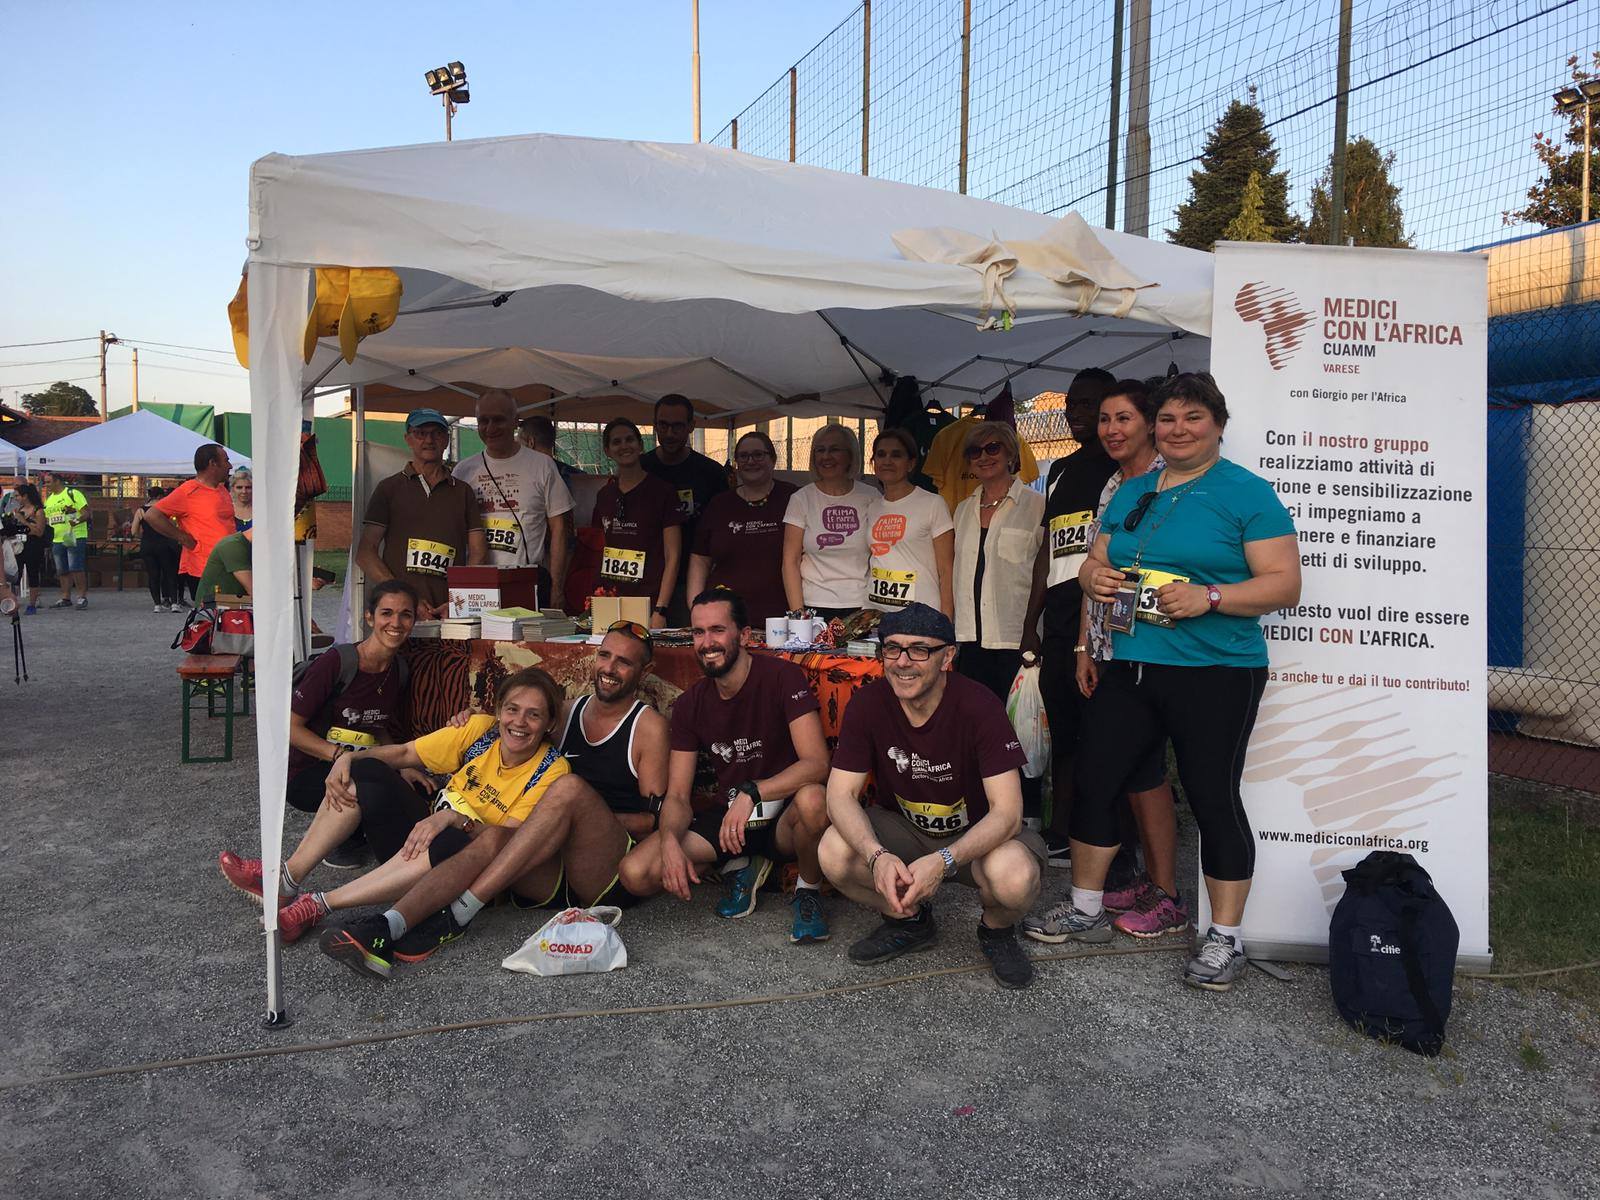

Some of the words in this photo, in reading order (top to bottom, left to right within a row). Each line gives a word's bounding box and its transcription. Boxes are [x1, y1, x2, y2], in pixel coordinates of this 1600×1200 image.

[1324, 298, 1397, 320] MEDICI
[1323, 320, 1367, 341] CON
[1375, 323, 1463, 345] L’AFRICA
[1323, 343, 1376, 357] CUAMM
[1323, 363, 1361, 374] VARESE
[1290, 389, 1309, 399] con
[1312, 389, 1348, 402] Giorgio
[1351, 392, 1368, 403] per
[1371, 392, 1407, 403] l'Africa
[1266, 430, 1296, 446] Con
[1303, 432, 1312, 447] il
[1319, 433, 1368, 449] nostro
[1374, 438, 1429, 455] gruppo
[1259, 455, 1353, 473] realizziamo
[1359, 459, 1413, 476] attività
[1420, 461, 1435, 477] di
[1317, 483, 1327, 495] e
[1332, 482, 1472, 502] sensibilizzazione
[1308, 504, 1406, 524] impegniamo
[1412, 512, 1421, 524] a
[1053, 525, 1086, 548] 1824
[1341, 533, 1350, 545] e
[1356, 530, 1436, 549] finanziare
[412, 551, 450, 571] 1844
[604, 559, 639, 576] 1843
[1333, 553, 1348, 569] di
[1354, 556, 1427, 576] sviluppo.
[873, 580, 910, 598] 1847
[1278, 604, 1331, 620] questo
[1338, 605, 1371, 621] vuol
[1377, 607, 1409, 623] dire
[1415, 612, 1469, 626] essere
[1262, 624, 1313, 642] MEDICI
[1319, 627, 1353, 644] CON
[1282, 671, 1318, 684] anche
[1322, 672, 1333, 684] tu
[1338, 675, 1345, 685] e
[1349, 674, 1367, 686] dai
[1372, 674, 1379, 687] il
[1383, 676, 1401, 688] tuo
[1406, 677, 1470, 692] contributo!
[903, 807, 961, 831] 1846
[1259, 830, 1429, 852] www.mediciconlafrica.org
[549, 943, 593, 954] CONAD
